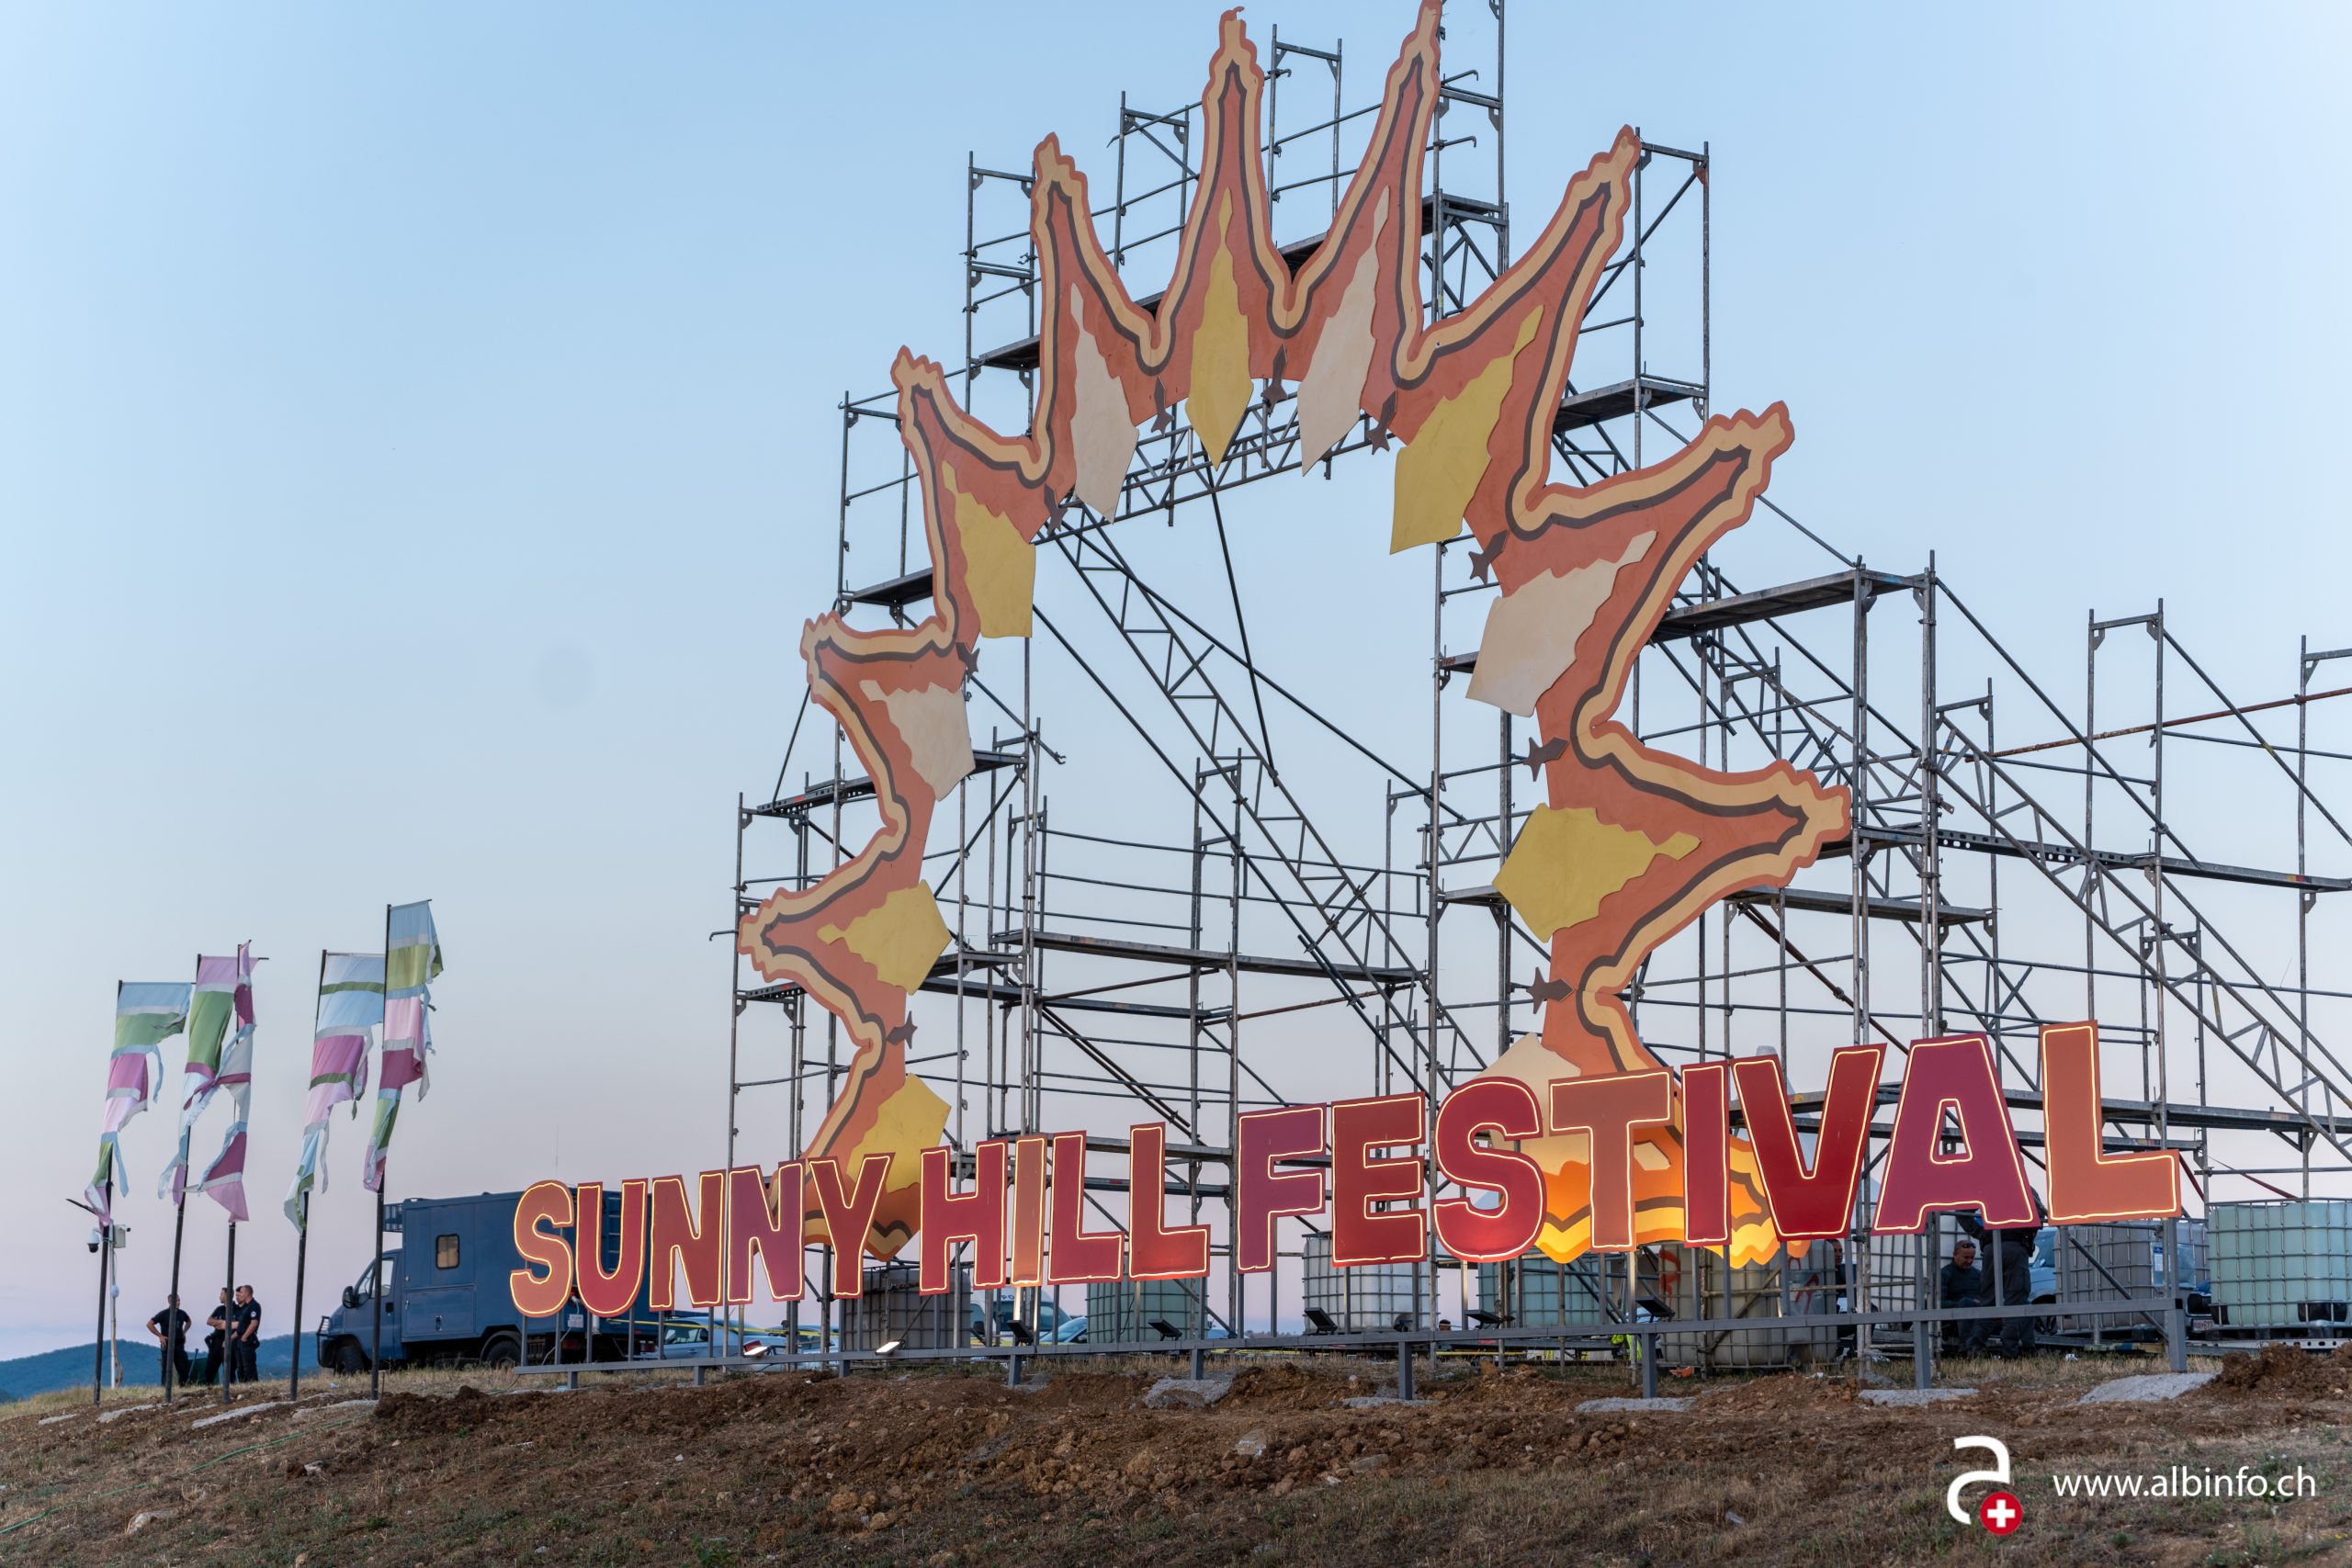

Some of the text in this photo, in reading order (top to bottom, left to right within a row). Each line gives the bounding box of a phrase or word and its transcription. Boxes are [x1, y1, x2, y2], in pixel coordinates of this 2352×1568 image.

[511, 1020, 2181, 1317] SUNNY HILL FESTIVAL
